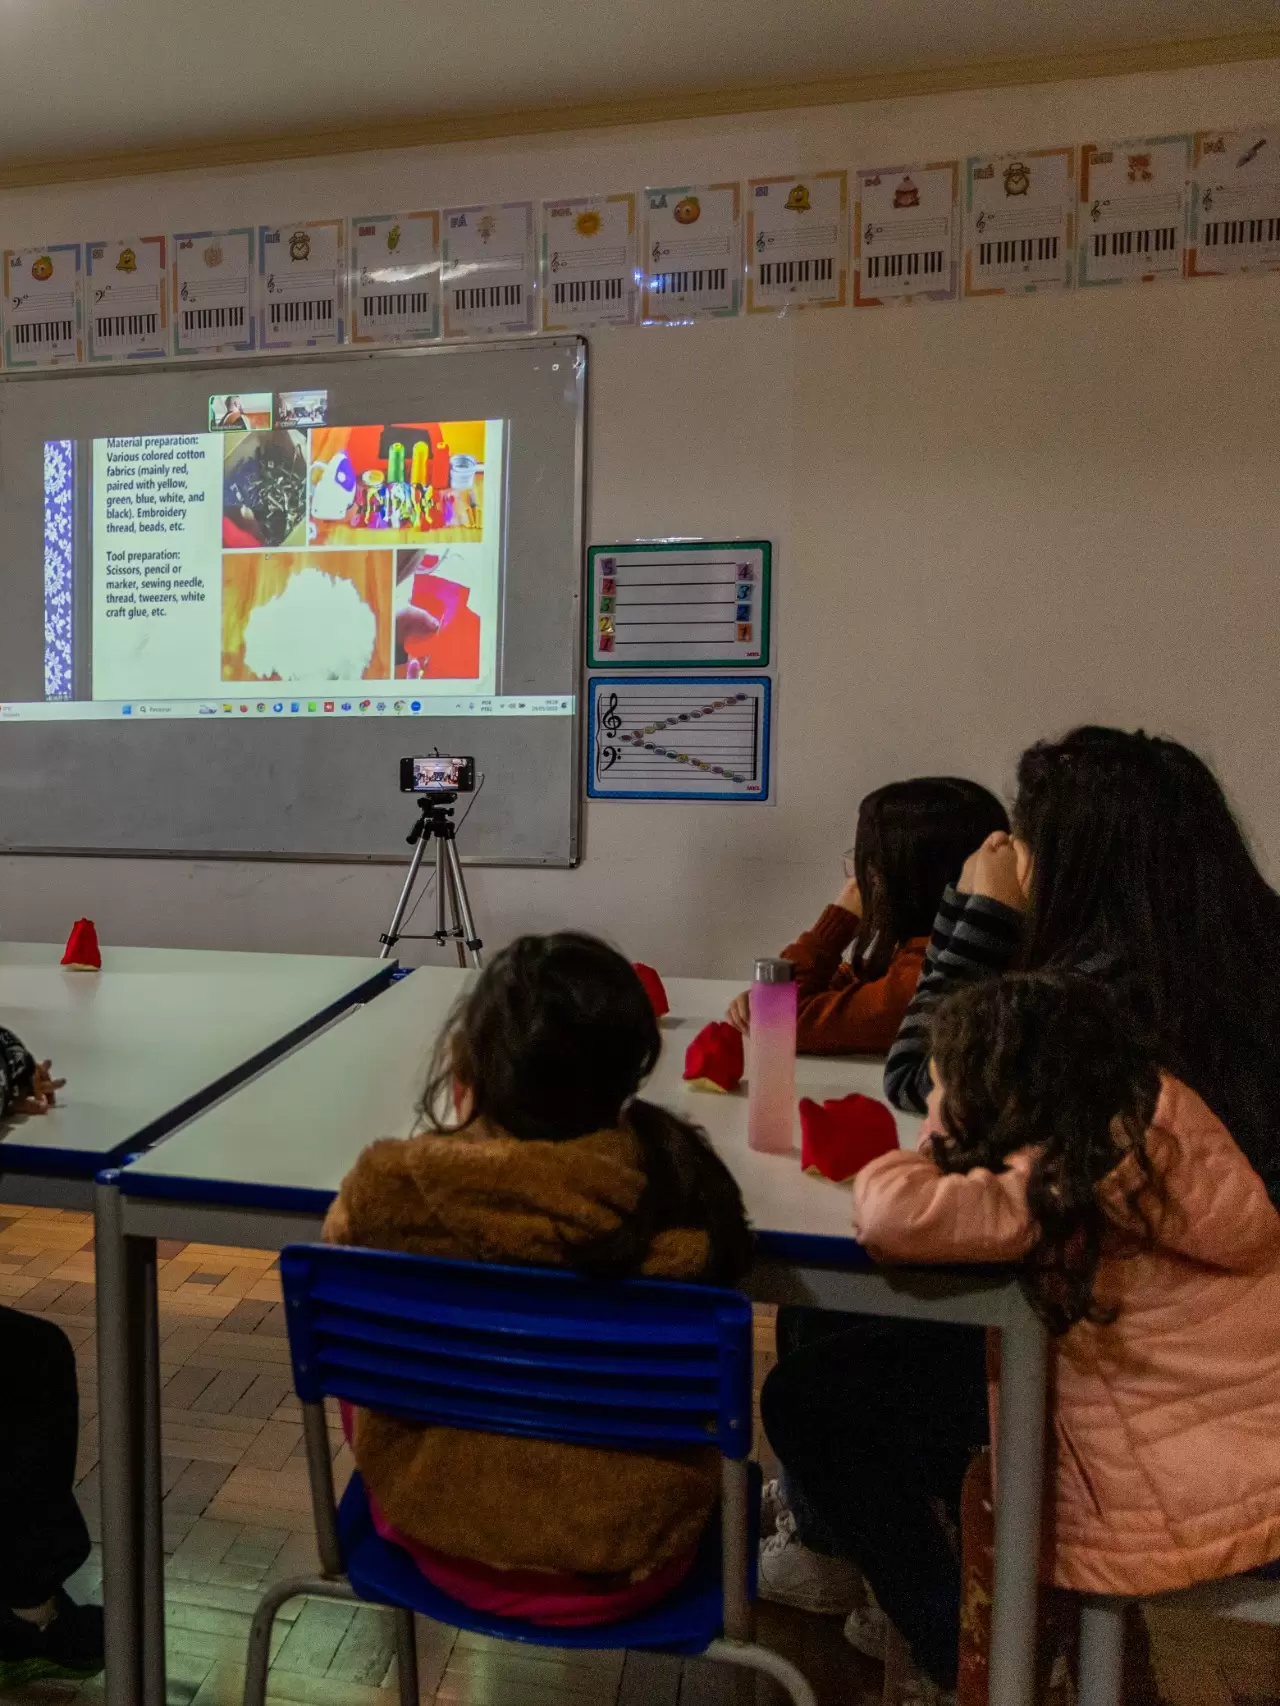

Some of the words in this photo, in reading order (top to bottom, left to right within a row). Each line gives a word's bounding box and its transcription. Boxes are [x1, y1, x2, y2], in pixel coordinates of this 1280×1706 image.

[650, 195, 668, 209] LÁ
[451, 214, 467, 228] FÁ
[107, 438, 142, 448] Material
[145, 436, 198, 449] preparation:
[107, 452, 139, 462] Various
[142, 449, 173, 460] colored
[177, 450, 205, 459] cotton
[107, 466, 135, 476] fabrics
[138, 465, 169, 477] (mainly
[172, 464, 188, 475] red,
[107, 480, 134, 492] paired
[137, 479, 155, 489] with
[157, 479, 187, 491] yellow,
[107, 496, 133, 507] green,
[136, 493, 157, 504] blue,
[159, 493, 185, 503] white,
[188, 492, 205, 502] and
[107, 508, 134, 519] black).
[138, 506, 186, 519] Embroidery
[107, 522, 136, 533] thread,
[139, 521, 166, 532] beads,
[169, 522, 185, 531] etc.
[106, 551, 125, 561] Tool
[128, 549, 180, 563] preparation:
[106, 565, 141, 576] Scissors,
[144, 564, 169, 577] pencil
[172, 565, 181, 573] or
[738, 565, 750, 578] 4
[106, 579, 138, 590] marker,
[141, 578, 171, 590] sewing
[174, 577, 204, 588] needle,
[106, 593, 136, 603] thread,
[139, 593, 178, 603] tweezers,
[181, 591, 205, 601] white
[737, 585, 750, 599] 3
[106, 607, 126, 618] craft
[128, 607, 149, 620] glue,
[151, 608, 166, 617] etc.
